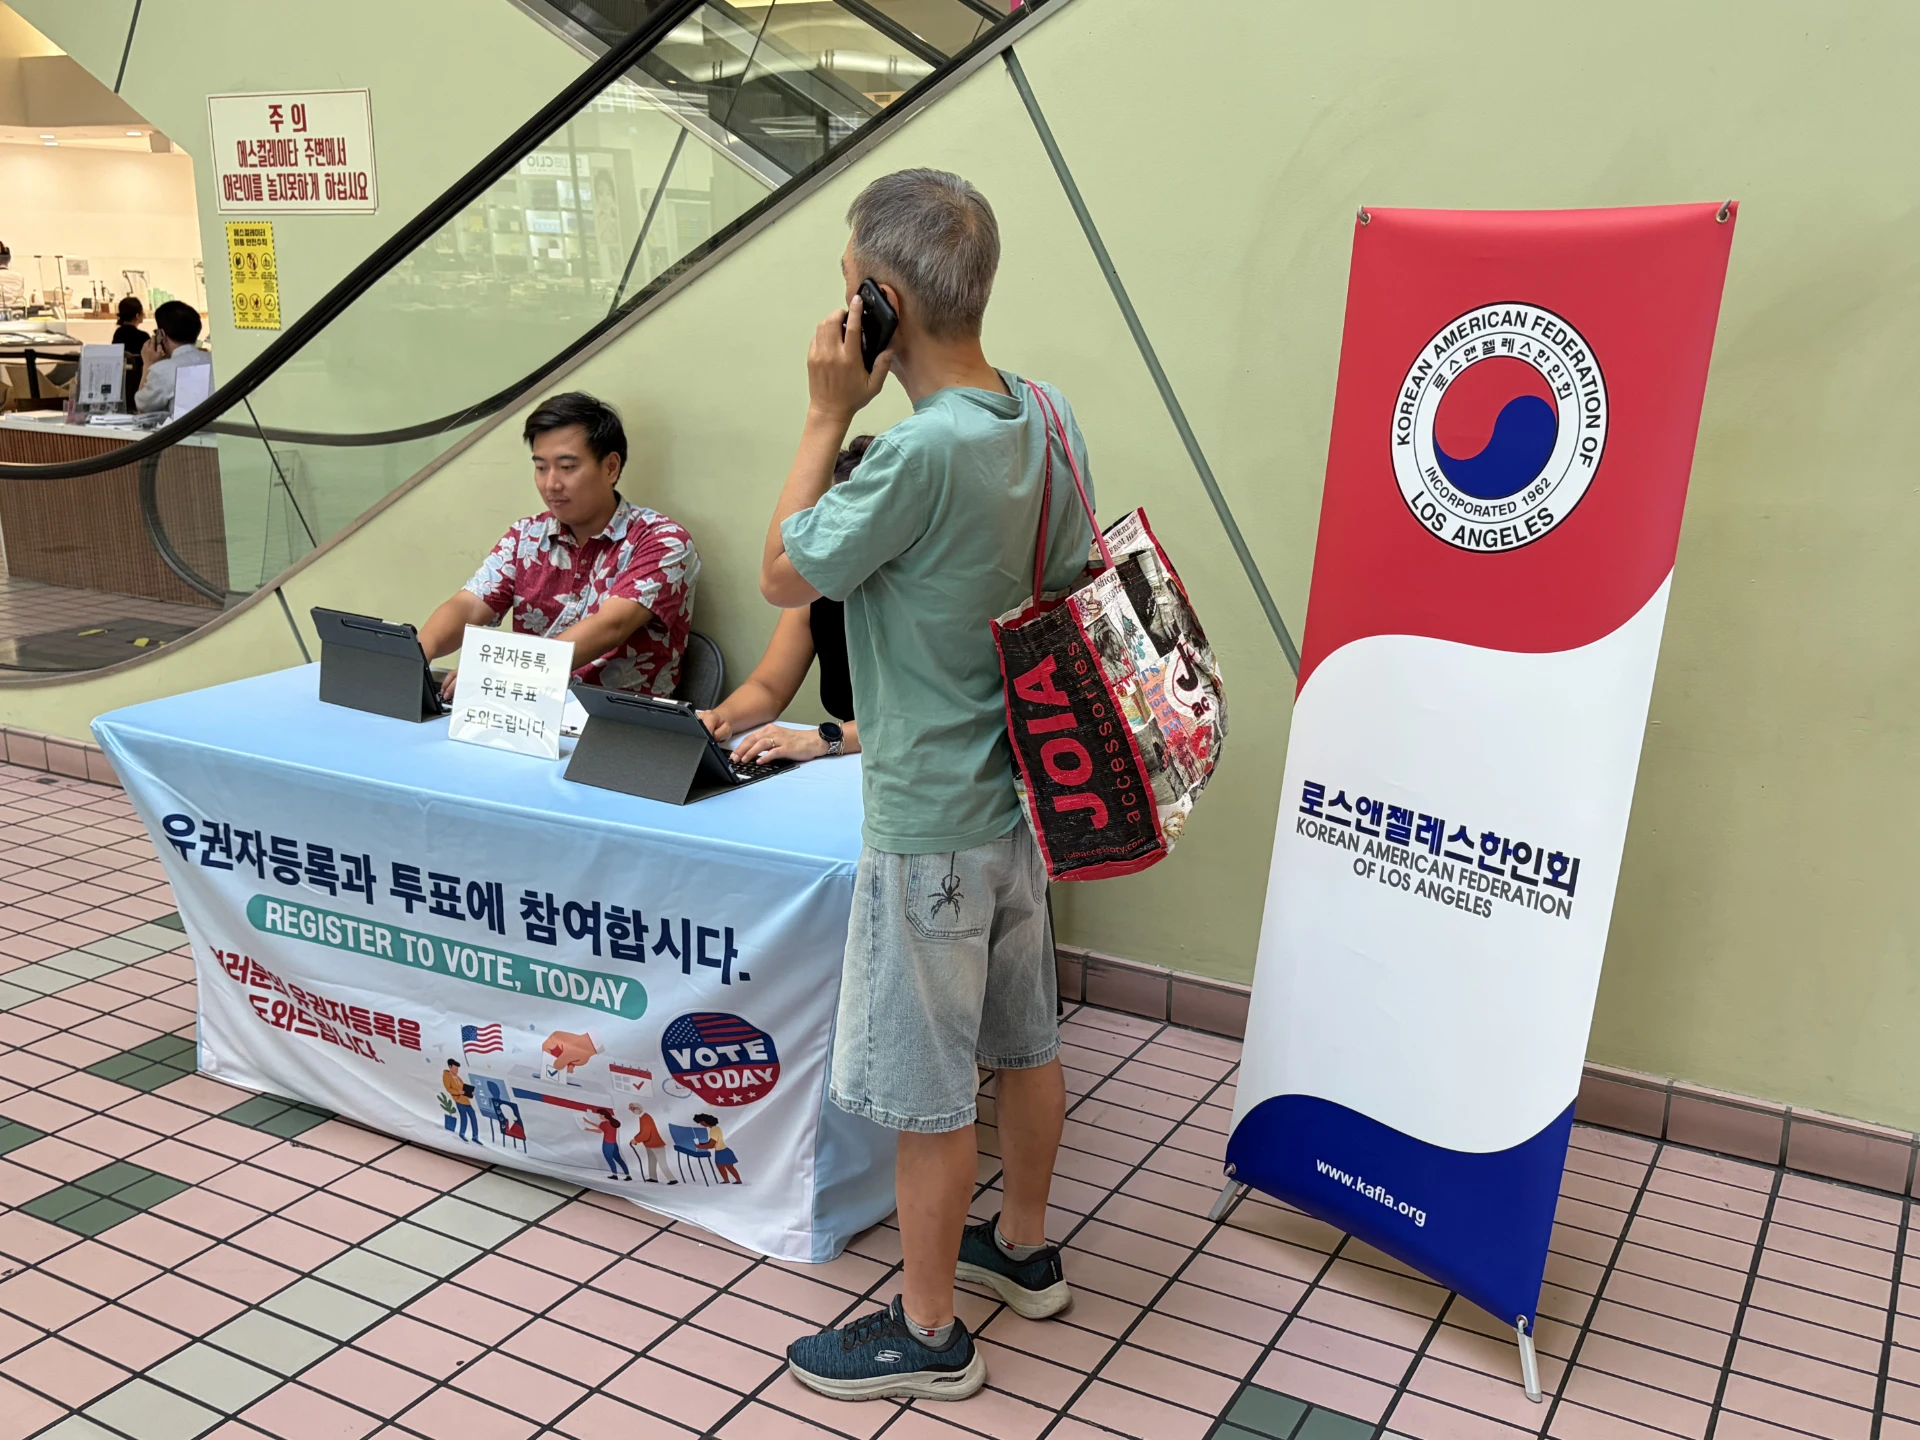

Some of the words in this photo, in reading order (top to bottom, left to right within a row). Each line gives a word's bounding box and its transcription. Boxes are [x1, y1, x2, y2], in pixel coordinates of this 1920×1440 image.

[237, 138, 299, 168] 에스컬레이타
[304, 137, 347, 167] 주변에서
[223, 173, 264, 202] 어린이를
[266, 172, 320, 202] 놀지못하게
[325, 172, 369, 201] 하십시요
[1397, 358, 1433, 446] KOREAN
[1433, 310, 1529, 360] AMERICAN
[1531, 314, 1602, 429] FEDERATION
[1579, 436, 1598, 469] OF
[1410, 490, 1448, 532] LOS
[1451, 507, 1555, 548] ANGELES
[1424, 466, 1517, 517] INCORPORATED
[1521, 477, 1552, 507] 1962
[479, 644, 550, 674] 유권자등록,
[481, 677, 507, 699] 우편
[464, 708, 545, 739] 도와드립니다
[1013, 653, 1109, 830] JOIA
[1067, 641, 1141, 826] accessories
[1296, 817, 1361, 853] KOREAN
[1363, 839, 1455, 882] AMERICAN
[1458, 867, 1573, 920] FEDERATION
[1298, 779, 1581, 898] 로스앤젤레스한인회
[162, 813, 377, 905] 유권자등록과
[390, 861, 506, 935] 투표에
[519, 889, 751, 985] 참여합시다.
[1353, 857, 1377, 879] OF
[1379, 865, 1412, 891] LOS
[1414, 878, 1493, 919] ANGELES
[265, 900, 393, 958] REGISTER
[400, 933, 435, 968] TO
[441, 943, 521, 992] VOTE,
[529, 963, 629, 1012] TODAY
[288, 982, 422, 1052] 유권자등록을
[668, 1038, 769, 1070] VOTE
[682, 1067, 773, 1090] TODAY
[1316, 1158, 1427, 1228] www.kafla.org
